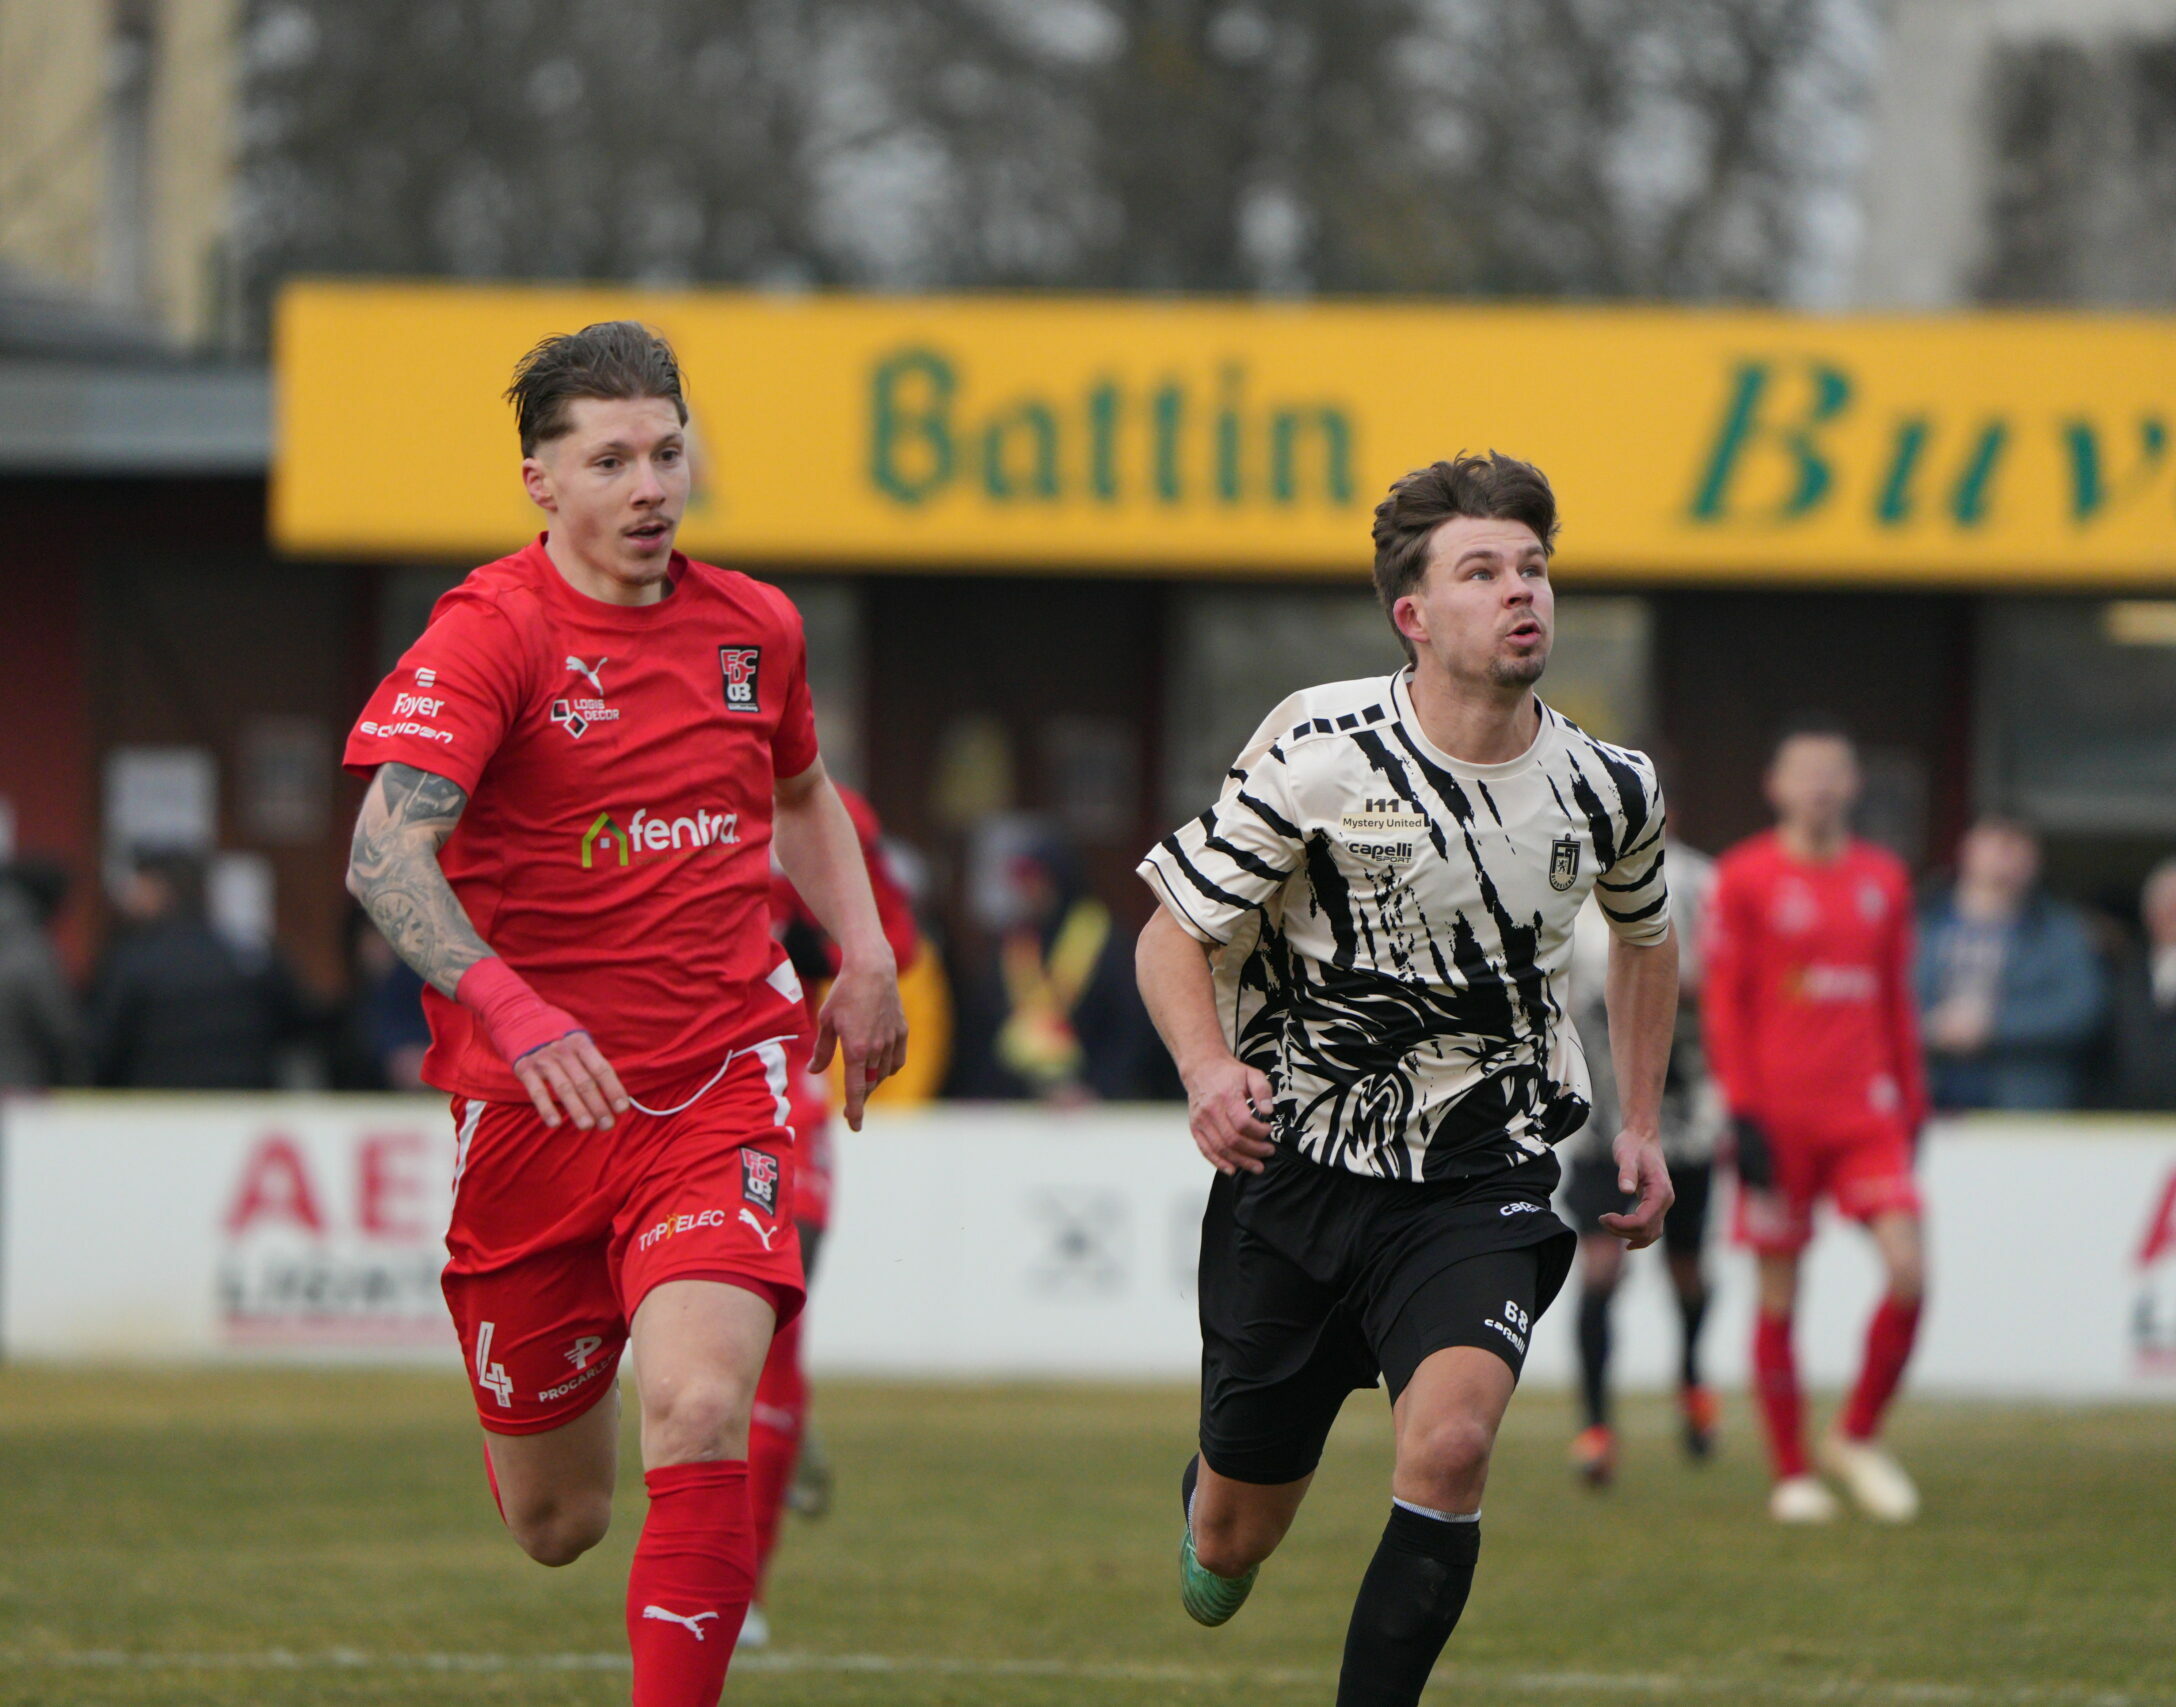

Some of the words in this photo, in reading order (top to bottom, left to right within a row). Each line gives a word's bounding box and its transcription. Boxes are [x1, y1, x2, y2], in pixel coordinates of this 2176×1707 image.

[866, 345, 1359, 506] Battin
[392, 693, 445, 718] Foyer
[574, 699, 605, 709] LOGIS
[1343, 818, 1384, 829] Mystery
[1387, 819, 1421, 828] United
[1349, 842, 1412, 859] capelli
[1504, 1300, 1529, 1334] 68
[476, 1321, 514, 1409] 4
